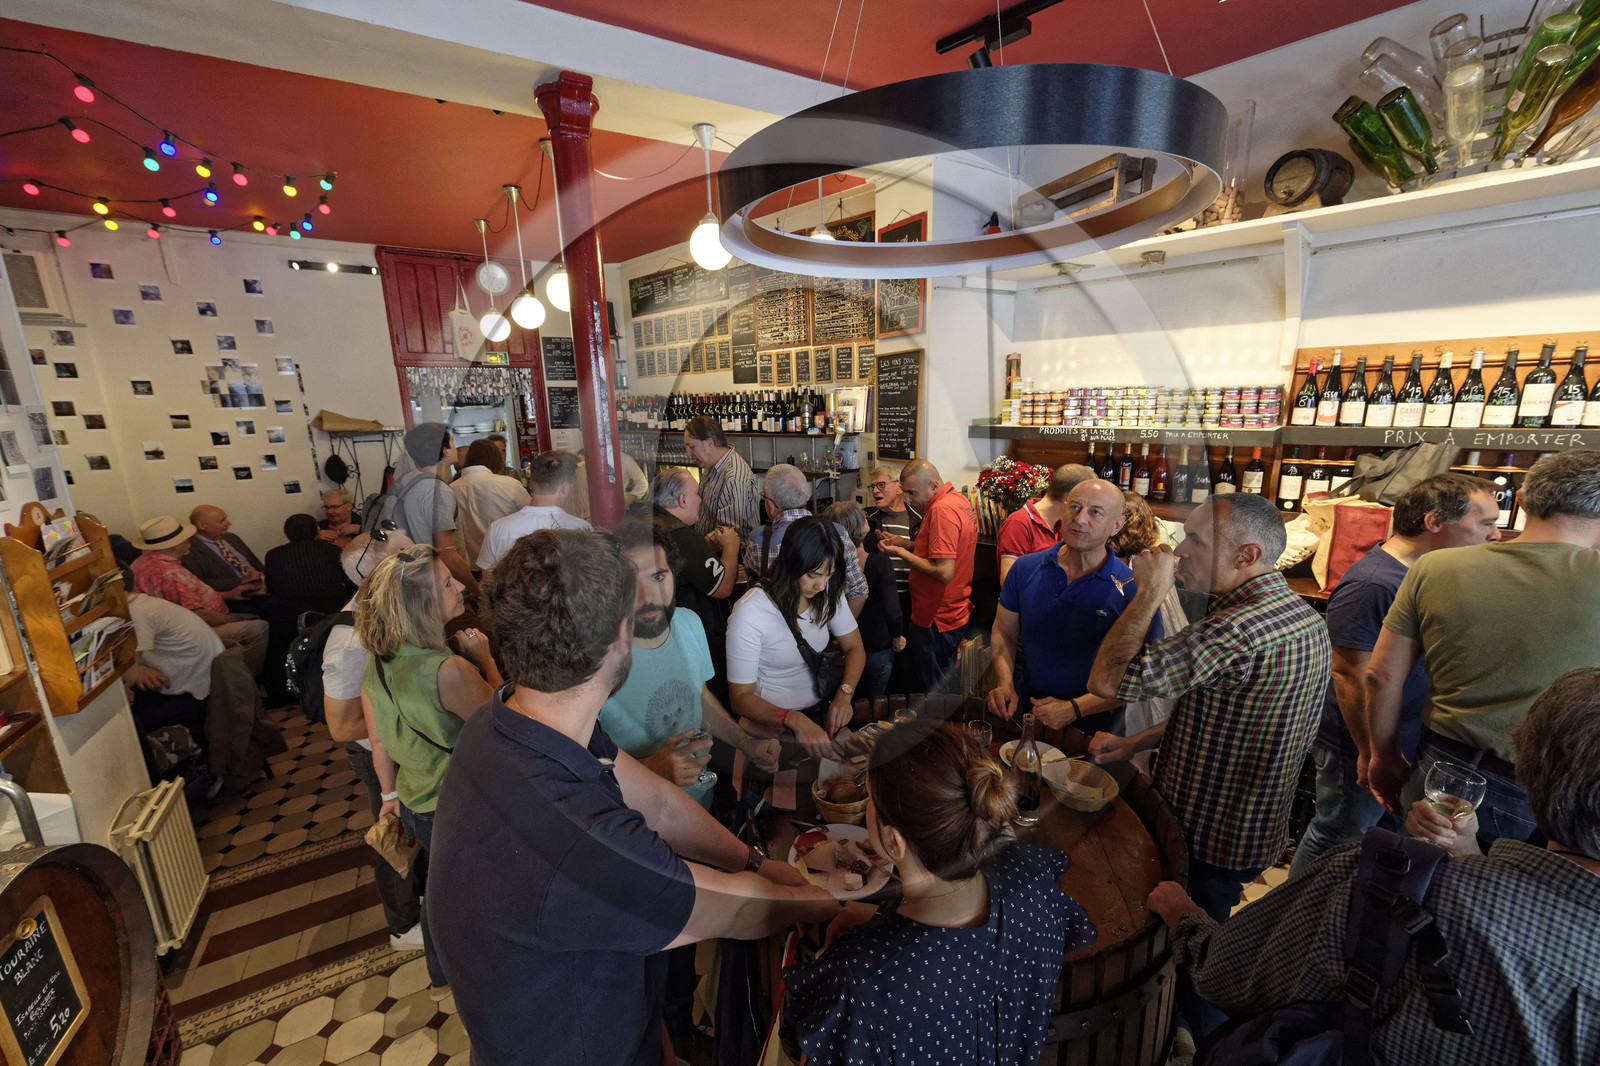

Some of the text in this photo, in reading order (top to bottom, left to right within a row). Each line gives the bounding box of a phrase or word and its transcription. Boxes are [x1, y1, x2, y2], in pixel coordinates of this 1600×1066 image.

[1408, 386, 1422, 397] 15
[1568, 384, 1582, 394] 15
[1298, 395, 1309, 407] 8
[1039, 426, 1079, 435] PRODUITS
[1187, 431, 1229, 440] EMPORTER
[1384, 429, 1427, 444] PRIX
[1473, 431, 1586, 447] EMPORTER
[0, 920, 48, 981] TOURAINE
[13, 948, 44, 986] BLANC
